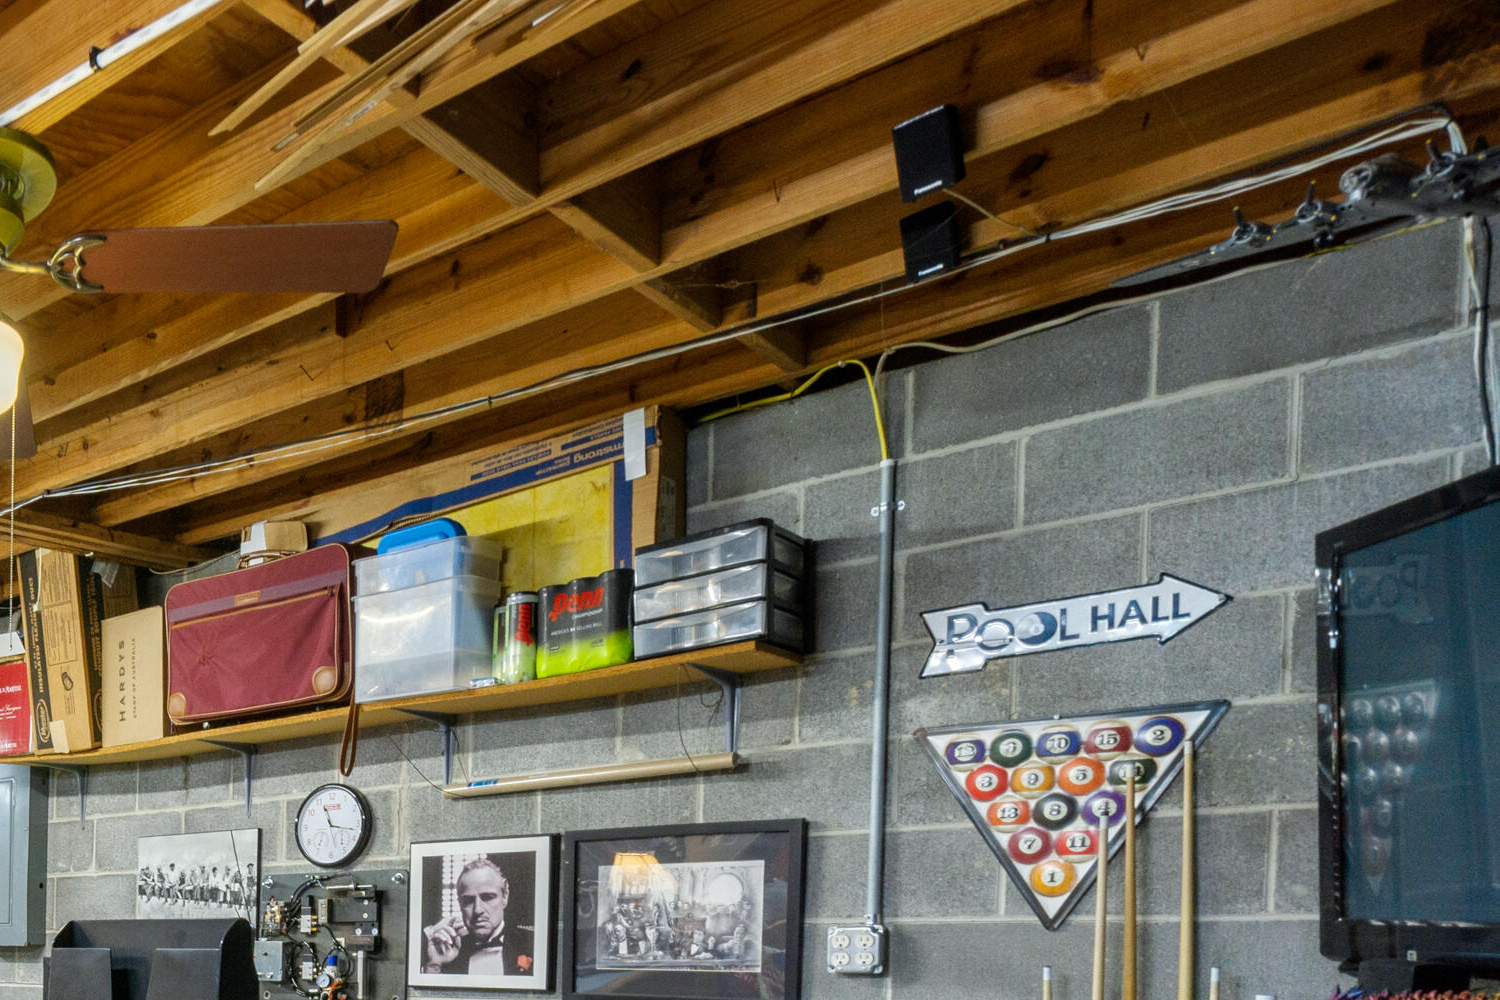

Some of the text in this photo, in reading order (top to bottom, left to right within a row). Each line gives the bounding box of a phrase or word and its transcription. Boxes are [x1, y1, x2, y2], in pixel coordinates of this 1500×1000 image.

[571, 441, 624, 465] rmstrong
[547, 586, 605, 622] penn
[515, 603, 533, 646] penn
[947, 593, 1191, 657] POOL HALL
[118, 639, 126, 722] HARDYS
[1098, 733, 1119, 746] 15
[1153, 729, 1165, 741] 2
[1048, 737, 1069, 749] 10
[957, 744, 975, 758] 12
[1027, 772, 1039, 786] 9
[1075, 767, 1087, 781] 5
[981, 775, 992, 788] 3
[999, 807, 1019, 819] 13
[1049, 804, 1061, 816] 8
[1098, 801, 1110, 812] 4
[1023, 838, 1037, 850] 7
[1069, 837, 1088, 848] 11
[1047, 872, 1056, 883] 1
